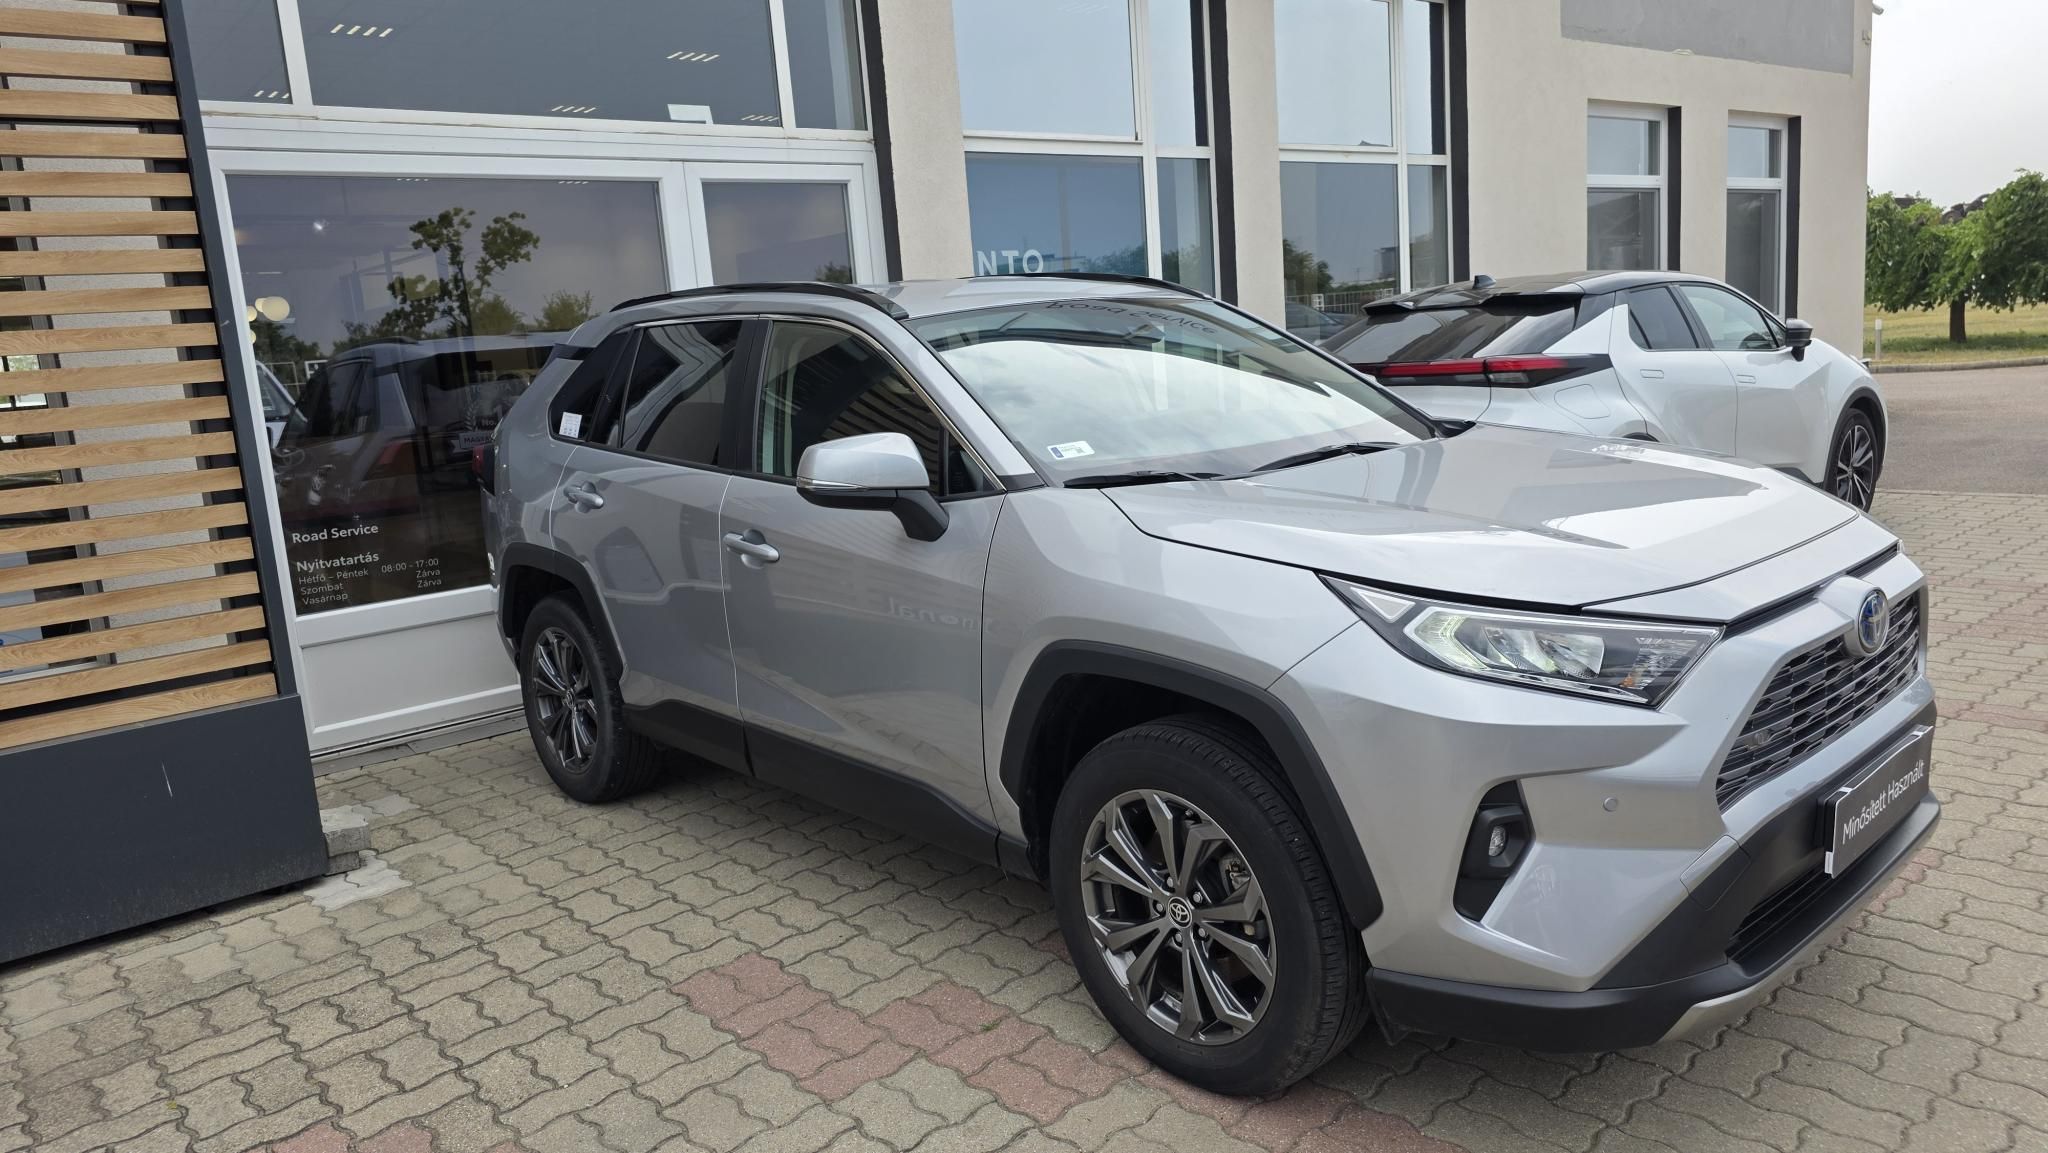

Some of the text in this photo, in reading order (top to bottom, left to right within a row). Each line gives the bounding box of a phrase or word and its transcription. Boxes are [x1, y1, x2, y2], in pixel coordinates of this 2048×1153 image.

[976, 249, 1044, 276] NTO
[292, 524, 379, 543] Road Service
[296, 552, 379, 572] Nyitvatartás
[336, 568, 369, 580] Péntek
[381, 562, 407, 573] 08:00
[415, 558, 439, 568] 17:00
[300, 569, 441, 595] Szombat Zárva
[302, 579, 442, 606] Vasárnap Zárva
[1842, 759, 1925, 845] Minősített Használt
